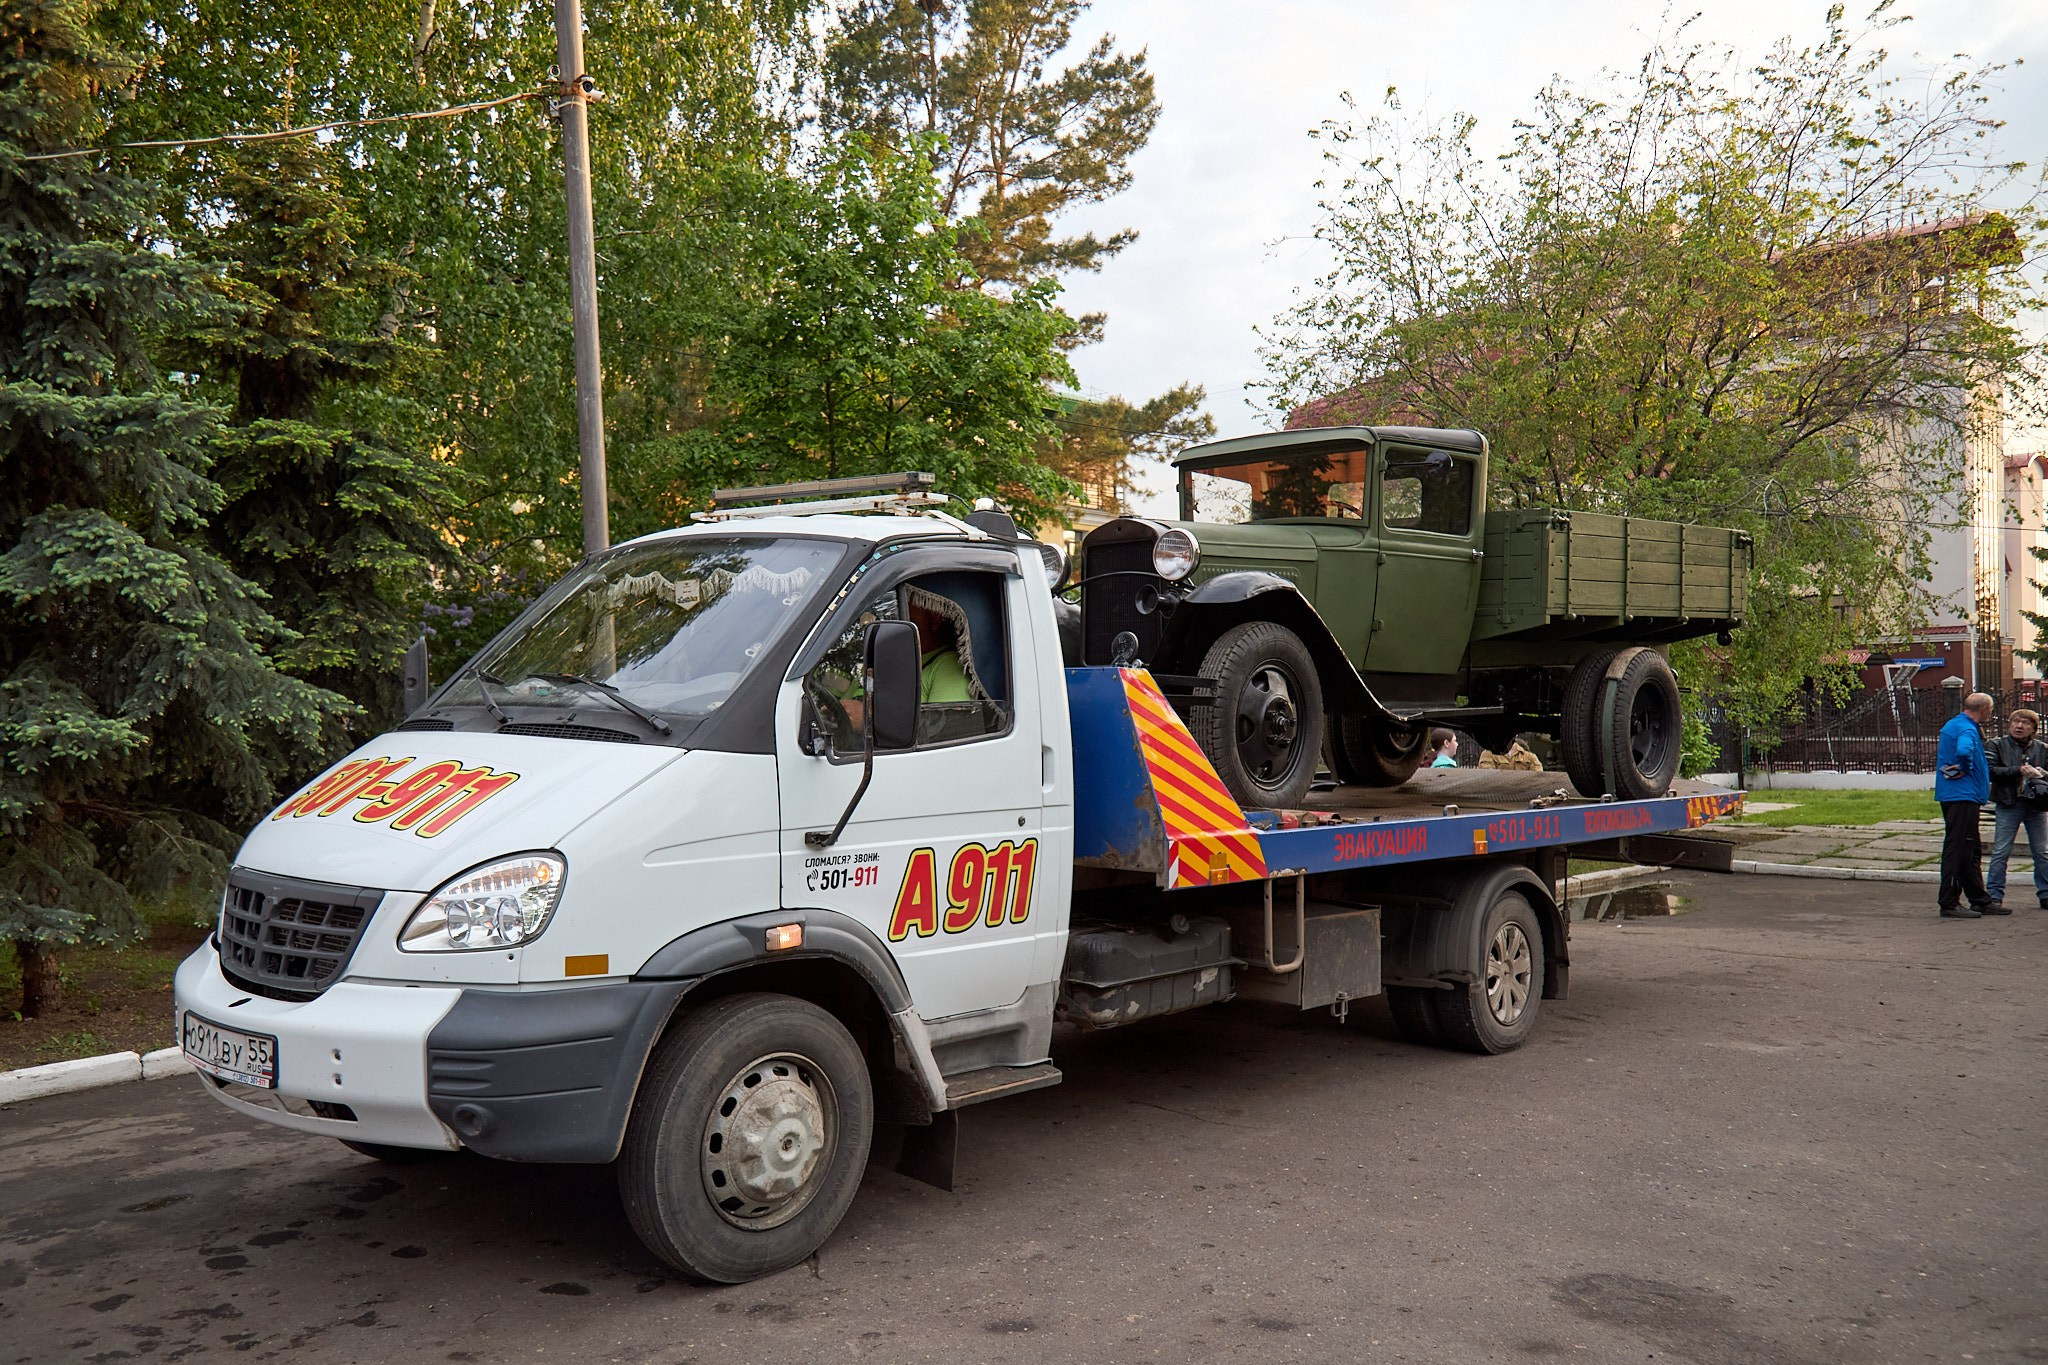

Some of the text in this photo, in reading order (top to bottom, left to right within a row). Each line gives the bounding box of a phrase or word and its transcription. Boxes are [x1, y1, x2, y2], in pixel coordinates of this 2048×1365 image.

[272, 756, 521, 838] 501-911
[1333, 826, 1427, 862] ЭВАКУАЦИЯ
[1499, 815, 1560, 843] 501-911
[805, 852, 880, 868] СЛОМАЛСЯ? ЗВОНИ:
[820, 865, 878, 890] 501-911
[943, 837, 1038, 933] 911
[248, 1038, 268, 1064] 55
[247, 1062, 262, 1074] RUS
